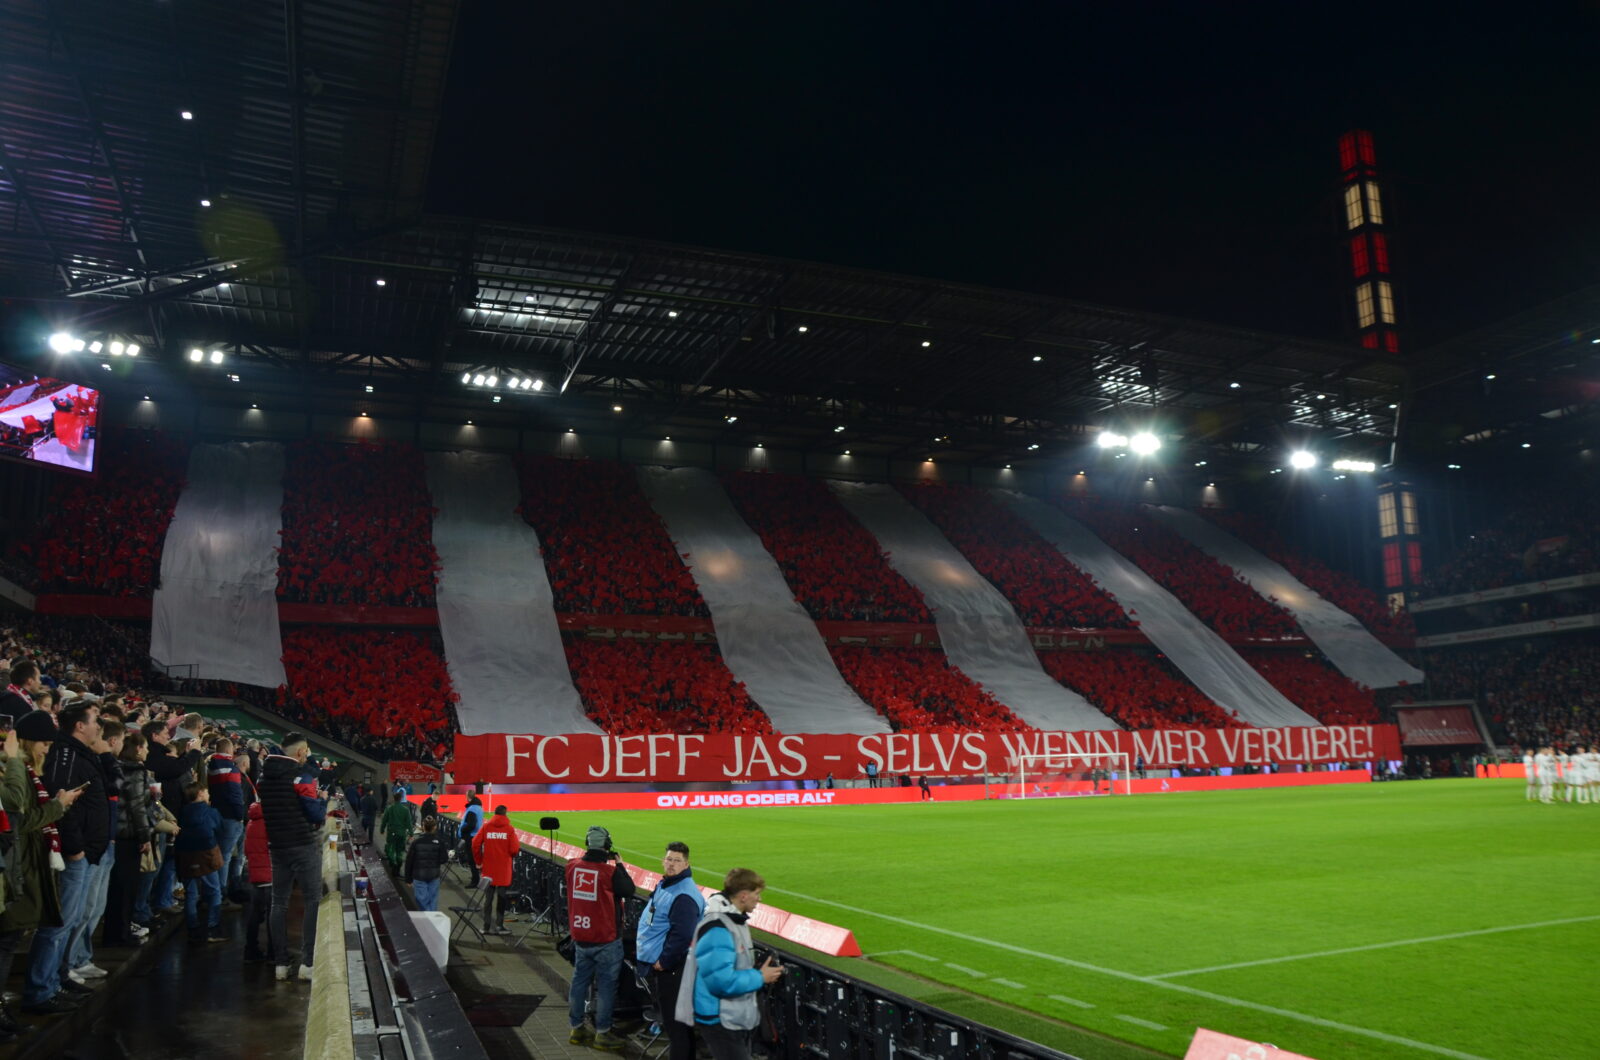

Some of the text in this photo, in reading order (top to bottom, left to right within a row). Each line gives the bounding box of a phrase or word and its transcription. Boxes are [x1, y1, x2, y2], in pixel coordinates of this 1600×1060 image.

[504, 734, 570, 779] FC
[588, 733, 705, 778] JEFF
[722, 735, 808, 778] JAS
[857, 732, 988, 774] SELVS
[1000, 731, 1120, 768] WENN
[1132, 729, 1210, 765] MER
[1216, 726, 1375, 763] VERLIERE!
[657, 792, 835, 807] OV JUNG ODER ALT
[486, 831, 508, 840] REWE
[573, 914, 591, 929] 28
